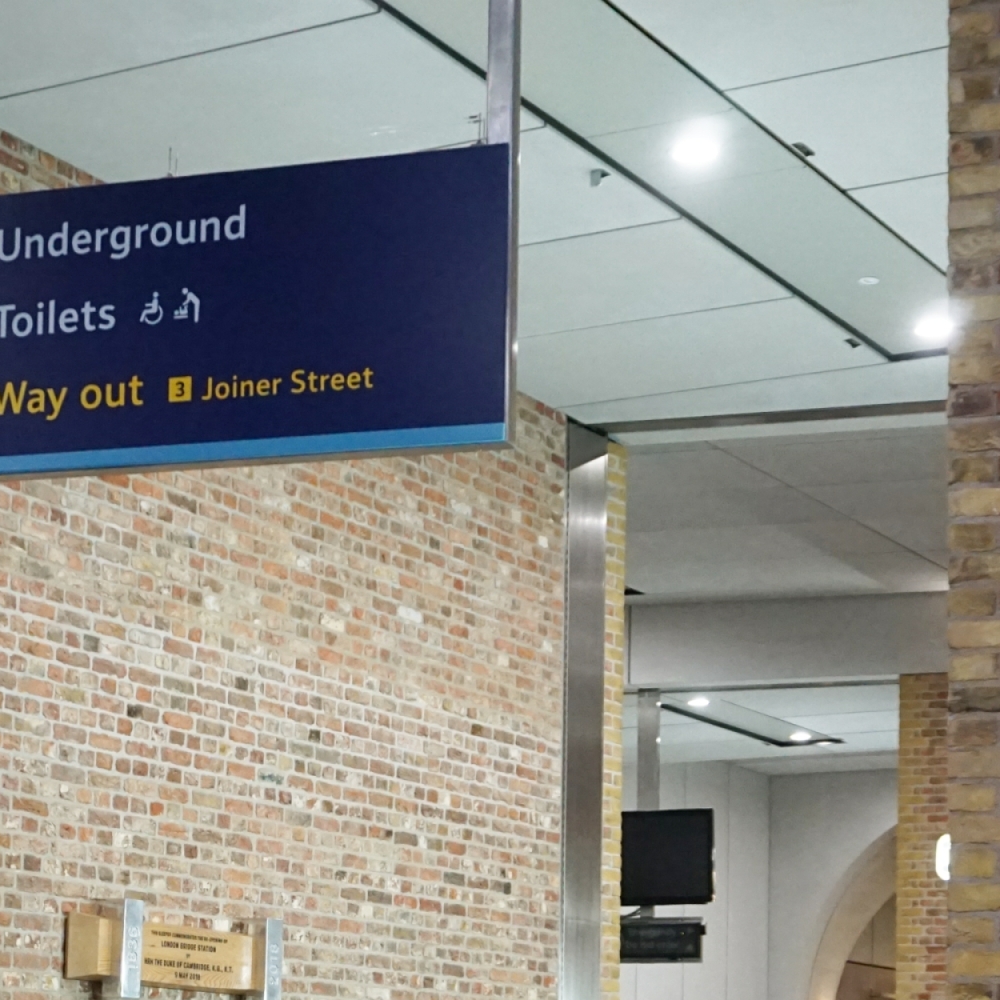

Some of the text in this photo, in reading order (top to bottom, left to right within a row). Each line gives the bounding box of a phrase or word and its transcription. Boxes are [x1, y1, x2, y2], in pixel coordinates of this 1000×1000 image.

[80, 375, 144, 410] out
[175, 380, 186, 397] 3
[201, 375, 282, 400] Joiner
[290, 367, 374, 393] Street
[128, 926, 139, 969] 1836
[161, 940, 216, 953] LONDON BRIDGE STATION
[163, 959, 175, 968] DUKE
[269, 943, 280, 986] 2018
